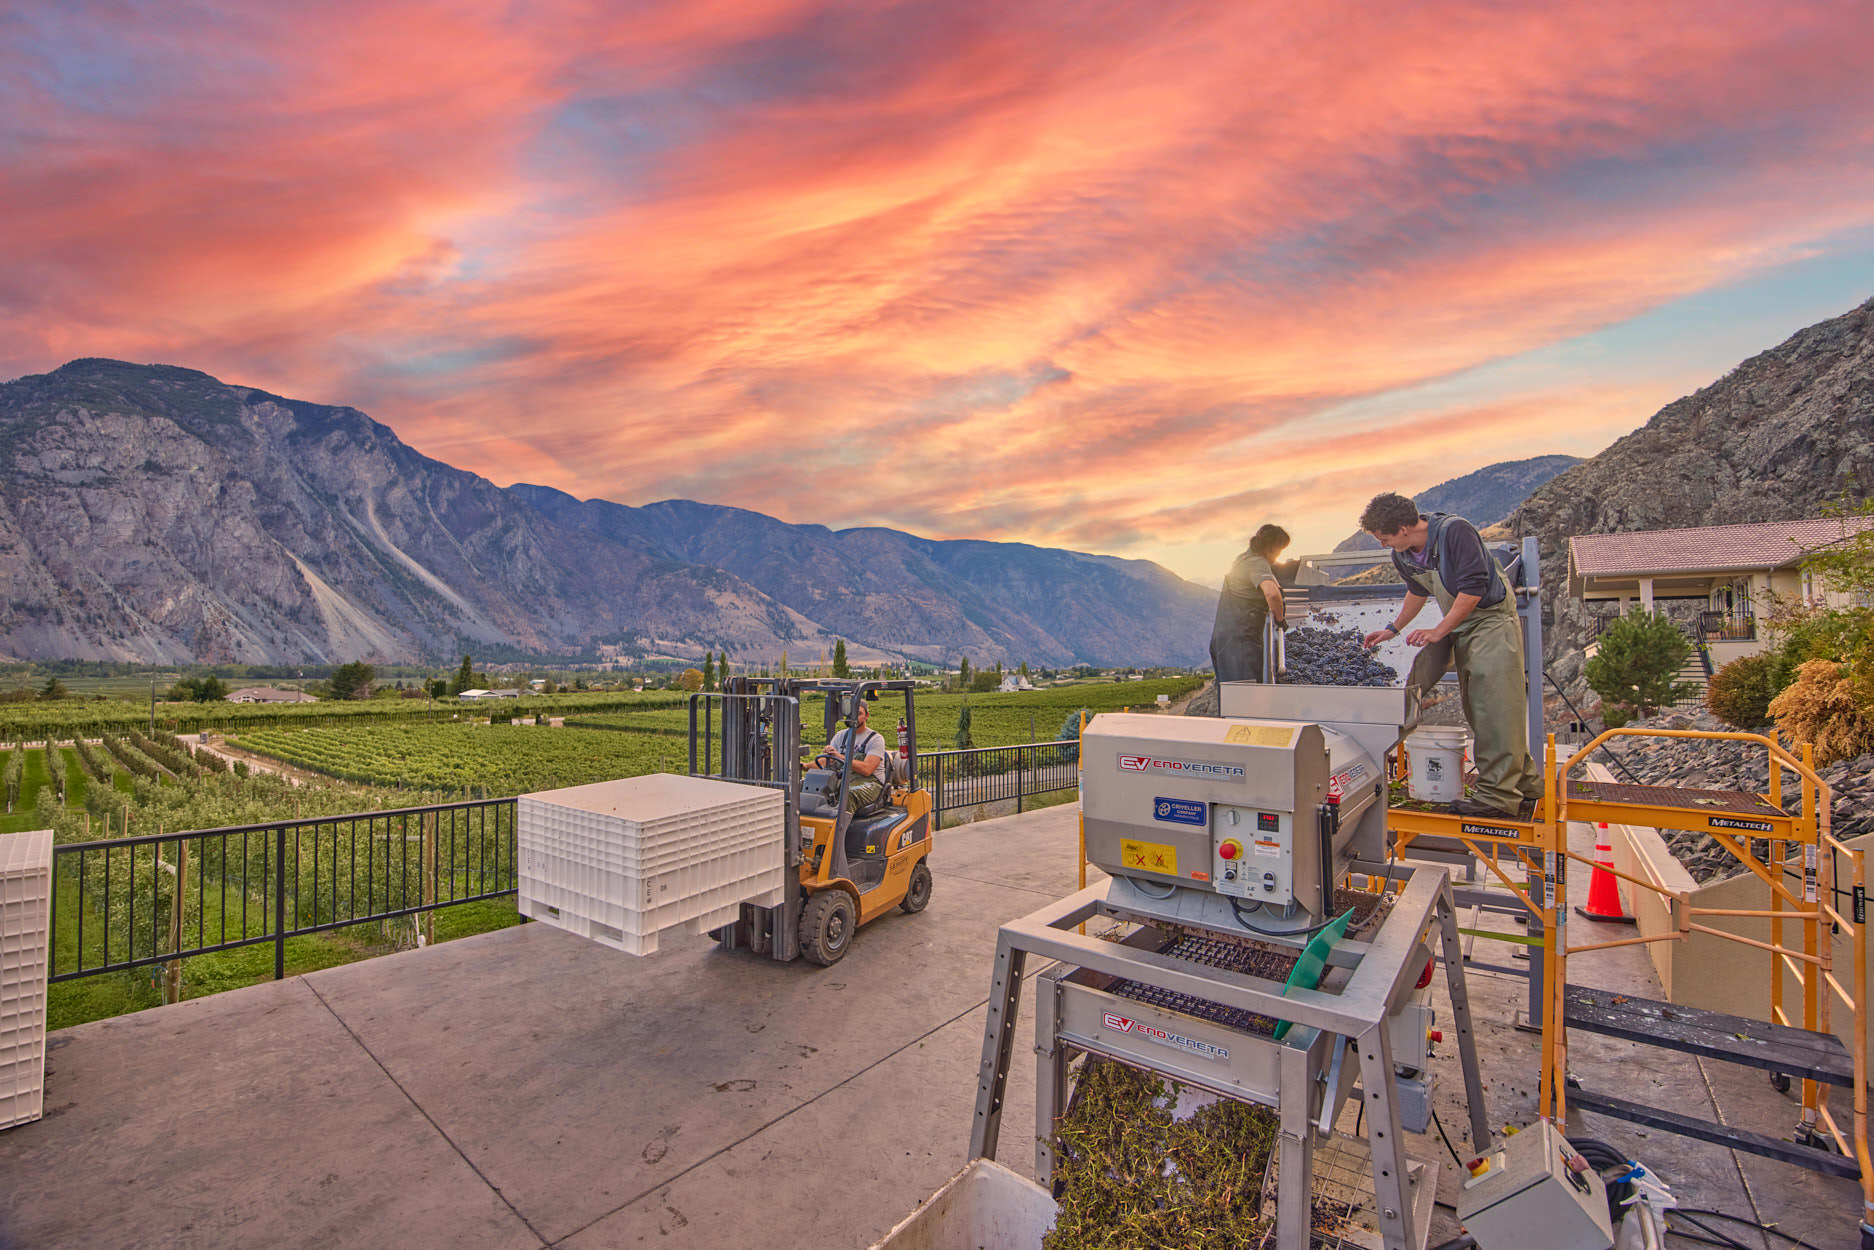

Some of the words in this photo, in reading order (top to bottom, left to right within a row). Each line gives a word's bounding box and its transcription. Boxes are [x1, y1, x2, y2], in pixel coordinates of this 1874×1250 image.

[1120, 756, 1151, 771] EV
[1153, 760, 1244, 776] ENOVENETA
[1464, 824, 1518, 838] METALTECH
[1711, 818, 1771, 831] METALTECH
[901, 830, 913, 847] CAT
[1104, 1013, 1135, 1032] EV
[1137, 1024, 1229, 1059] ENOVENETA
